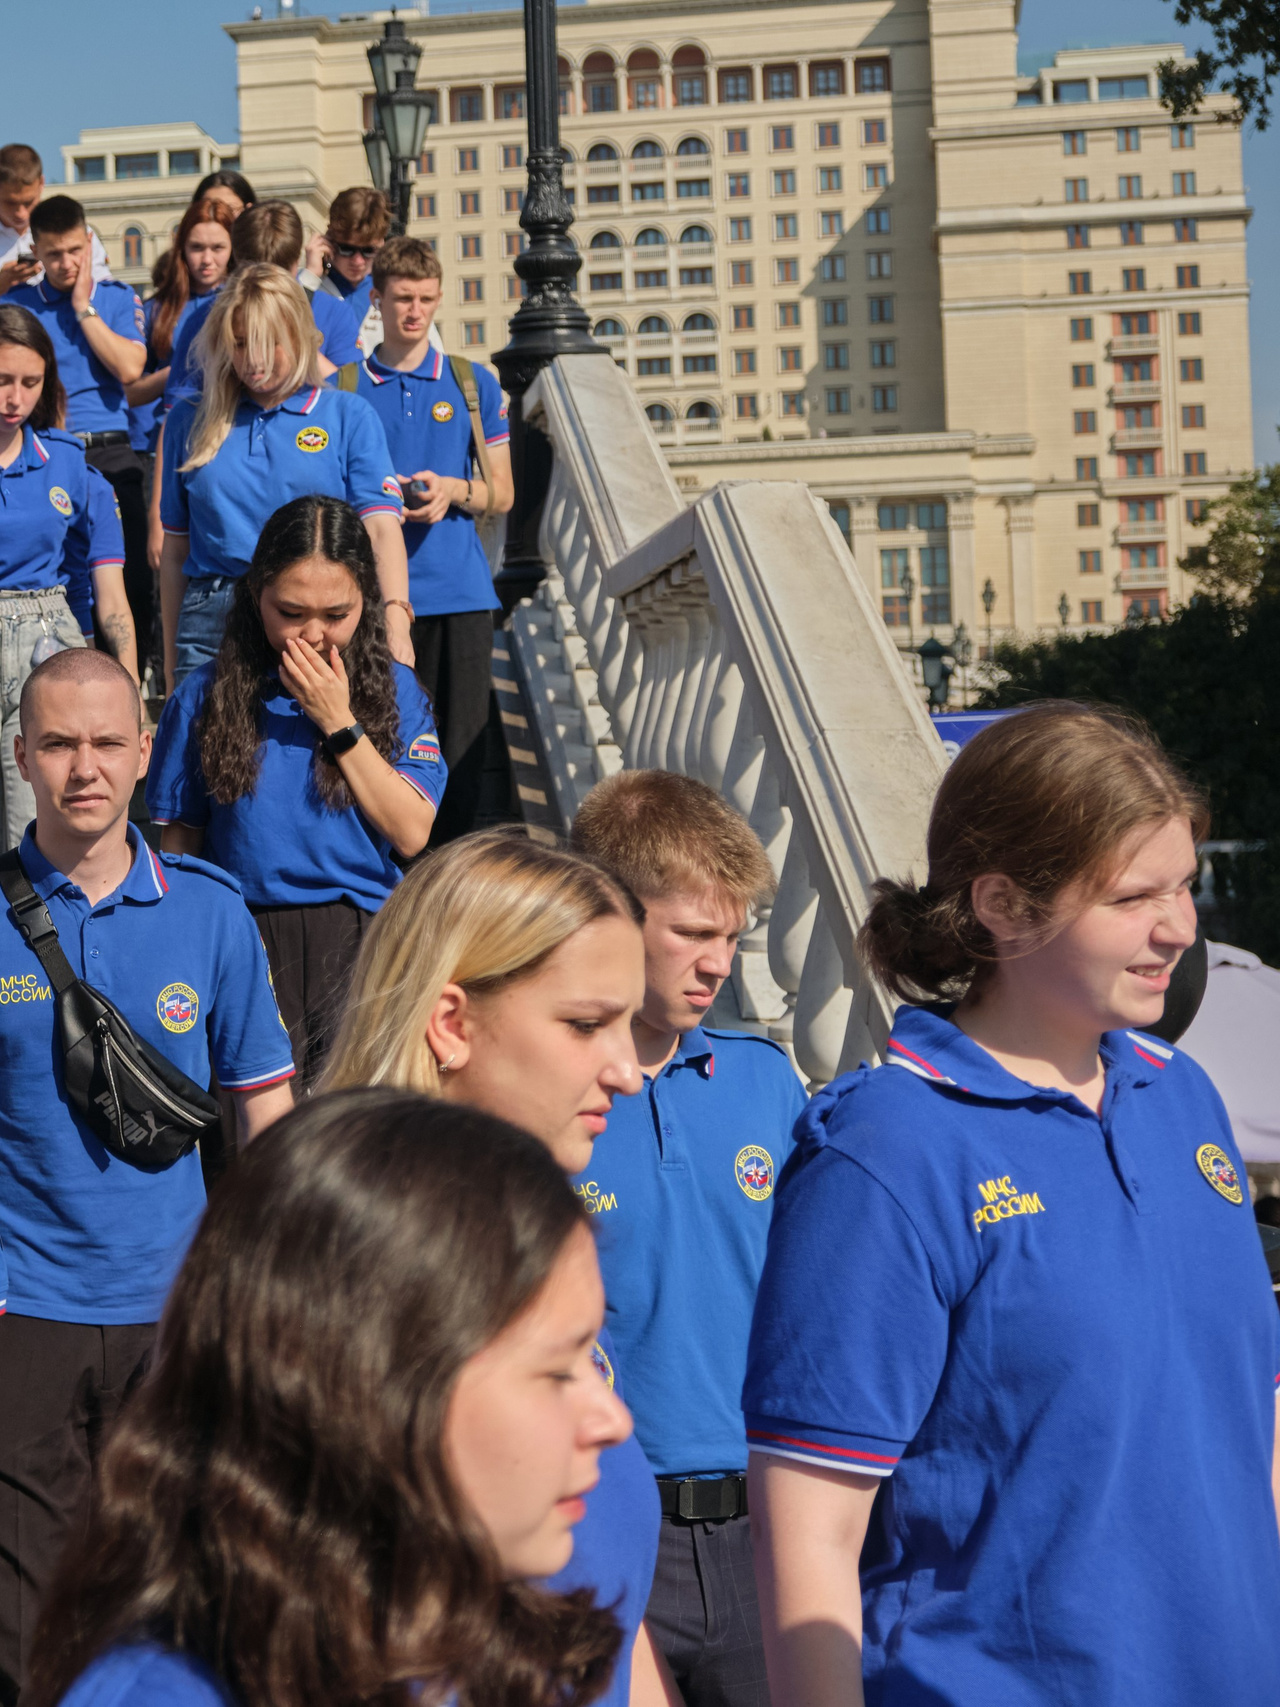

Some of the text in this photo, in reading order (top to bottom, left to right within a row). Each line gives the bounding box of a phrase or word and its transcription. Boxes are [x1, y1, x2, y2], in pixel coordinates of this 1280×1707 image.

[0, 974, 37, 991] МЧС
[572, 1181, 600, 1199] ЧС
[978, 1175, 1018, 1203] МЧС
[583, 1192, 618, 1214] СИИ
[973, 1192, 1046, 1233] РОССИИ
